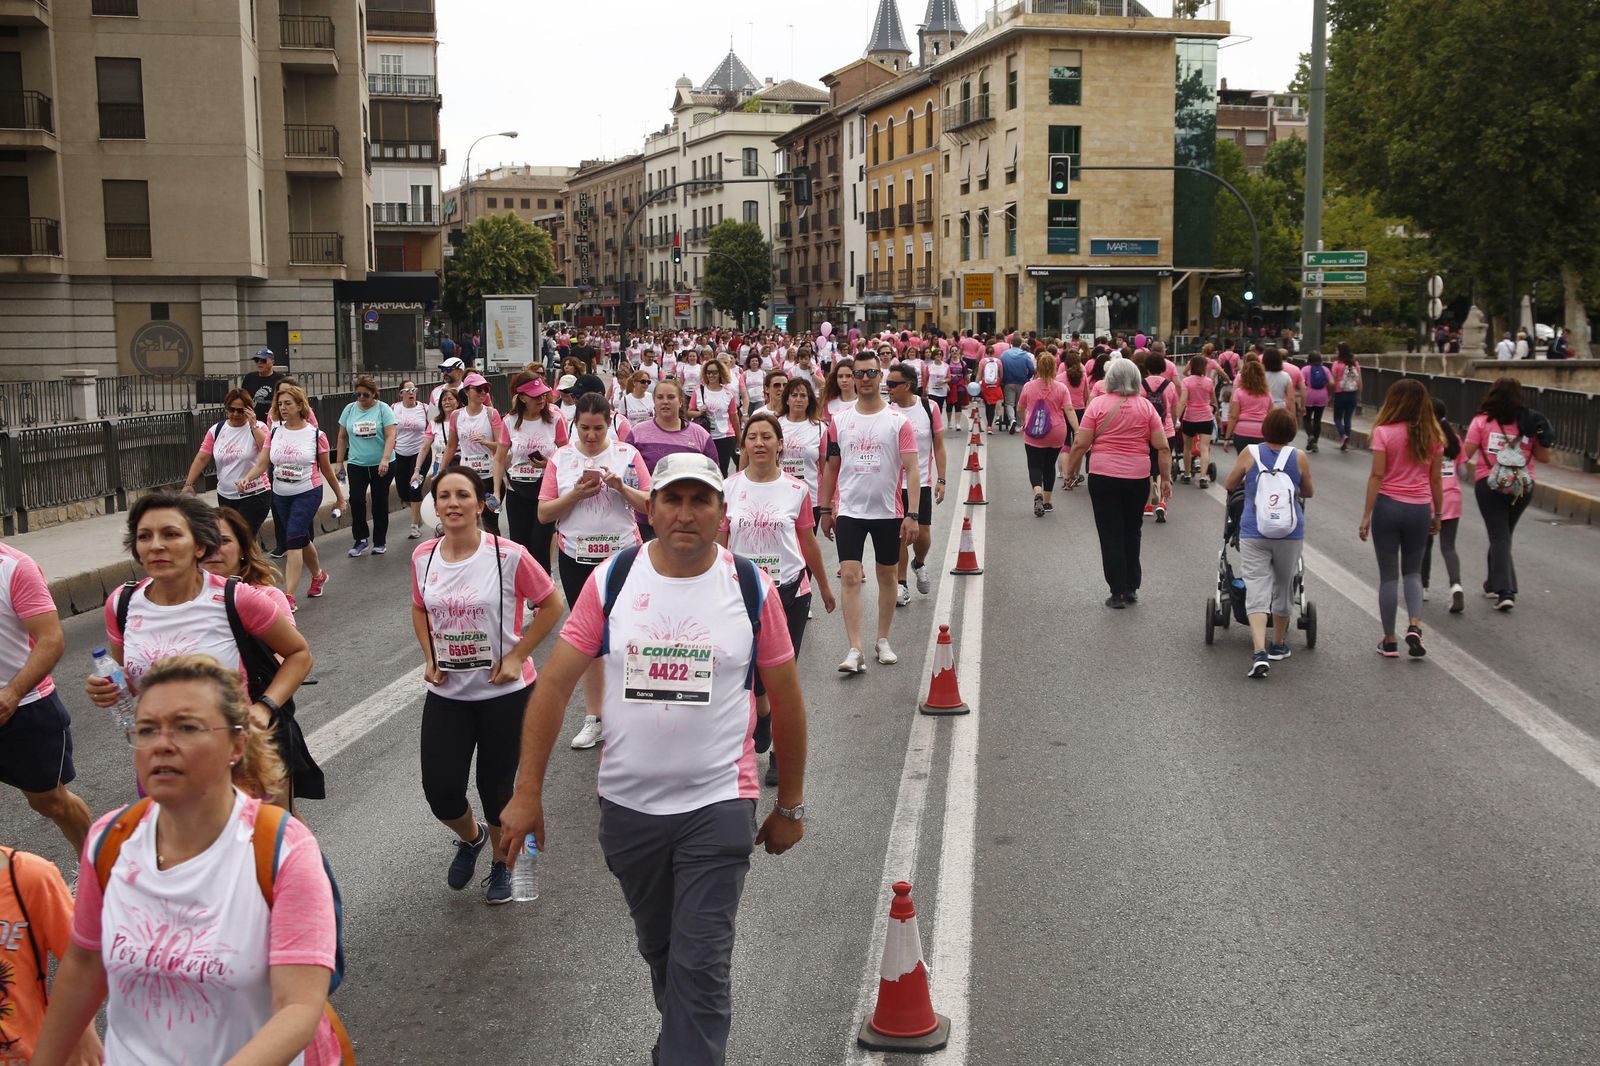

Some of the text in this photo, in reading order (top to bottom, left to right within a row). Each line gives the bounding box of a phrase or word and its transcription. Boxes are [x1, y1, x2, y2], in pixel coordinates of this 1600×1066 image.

[1106, 242, 1128, 251] MAR
[588, 543, 610, 553] 8338
[444, 633, 487, 641] COVIRAN
[448, 644, 477, 656] 6595
[642, 646, 711, 659] COVIRAN
[648, 662, 689, 681] 4422
[110, 932, 137, 965] Por
[167, 952, 231, 984] mujer
